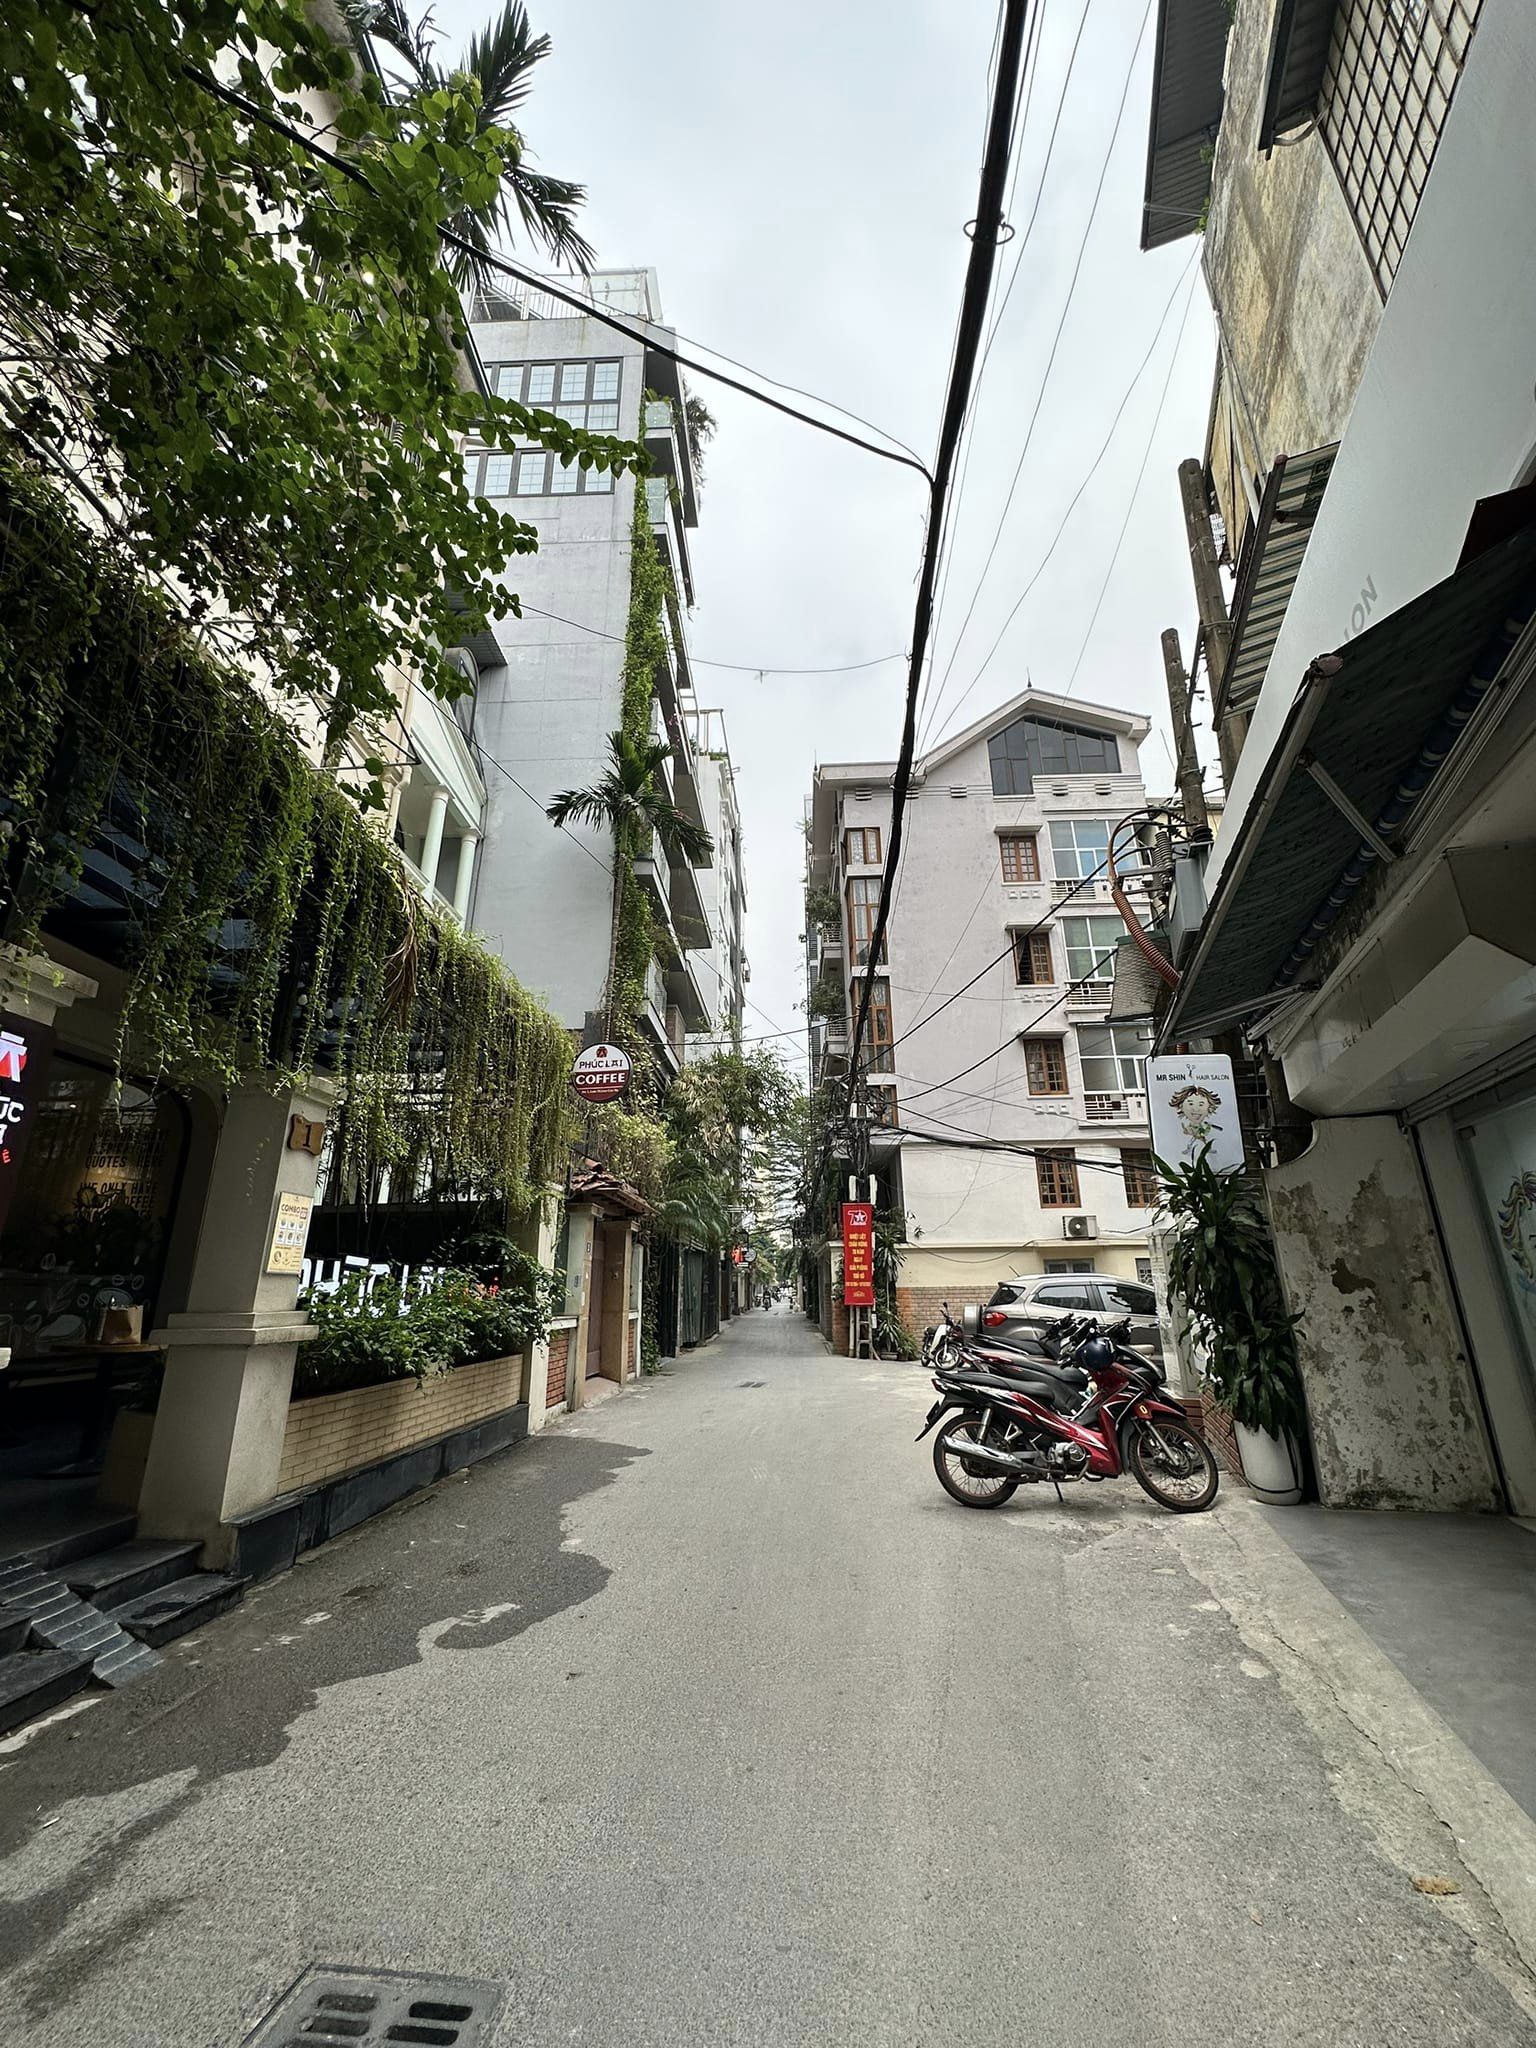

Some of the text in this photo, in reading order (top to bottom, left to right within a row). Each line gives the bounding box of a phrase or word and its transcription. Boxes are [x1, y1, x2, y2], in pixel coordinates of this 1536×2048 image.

[576, 1073, 626, 1085] COFFEE
[1168, 1073, 1186, 1081] SHIN
[303, 1124, 312, 1148] 1
[85, 1154, 128, 1169] QUOTES
[101, 1182, 127, 1195] ONLY
